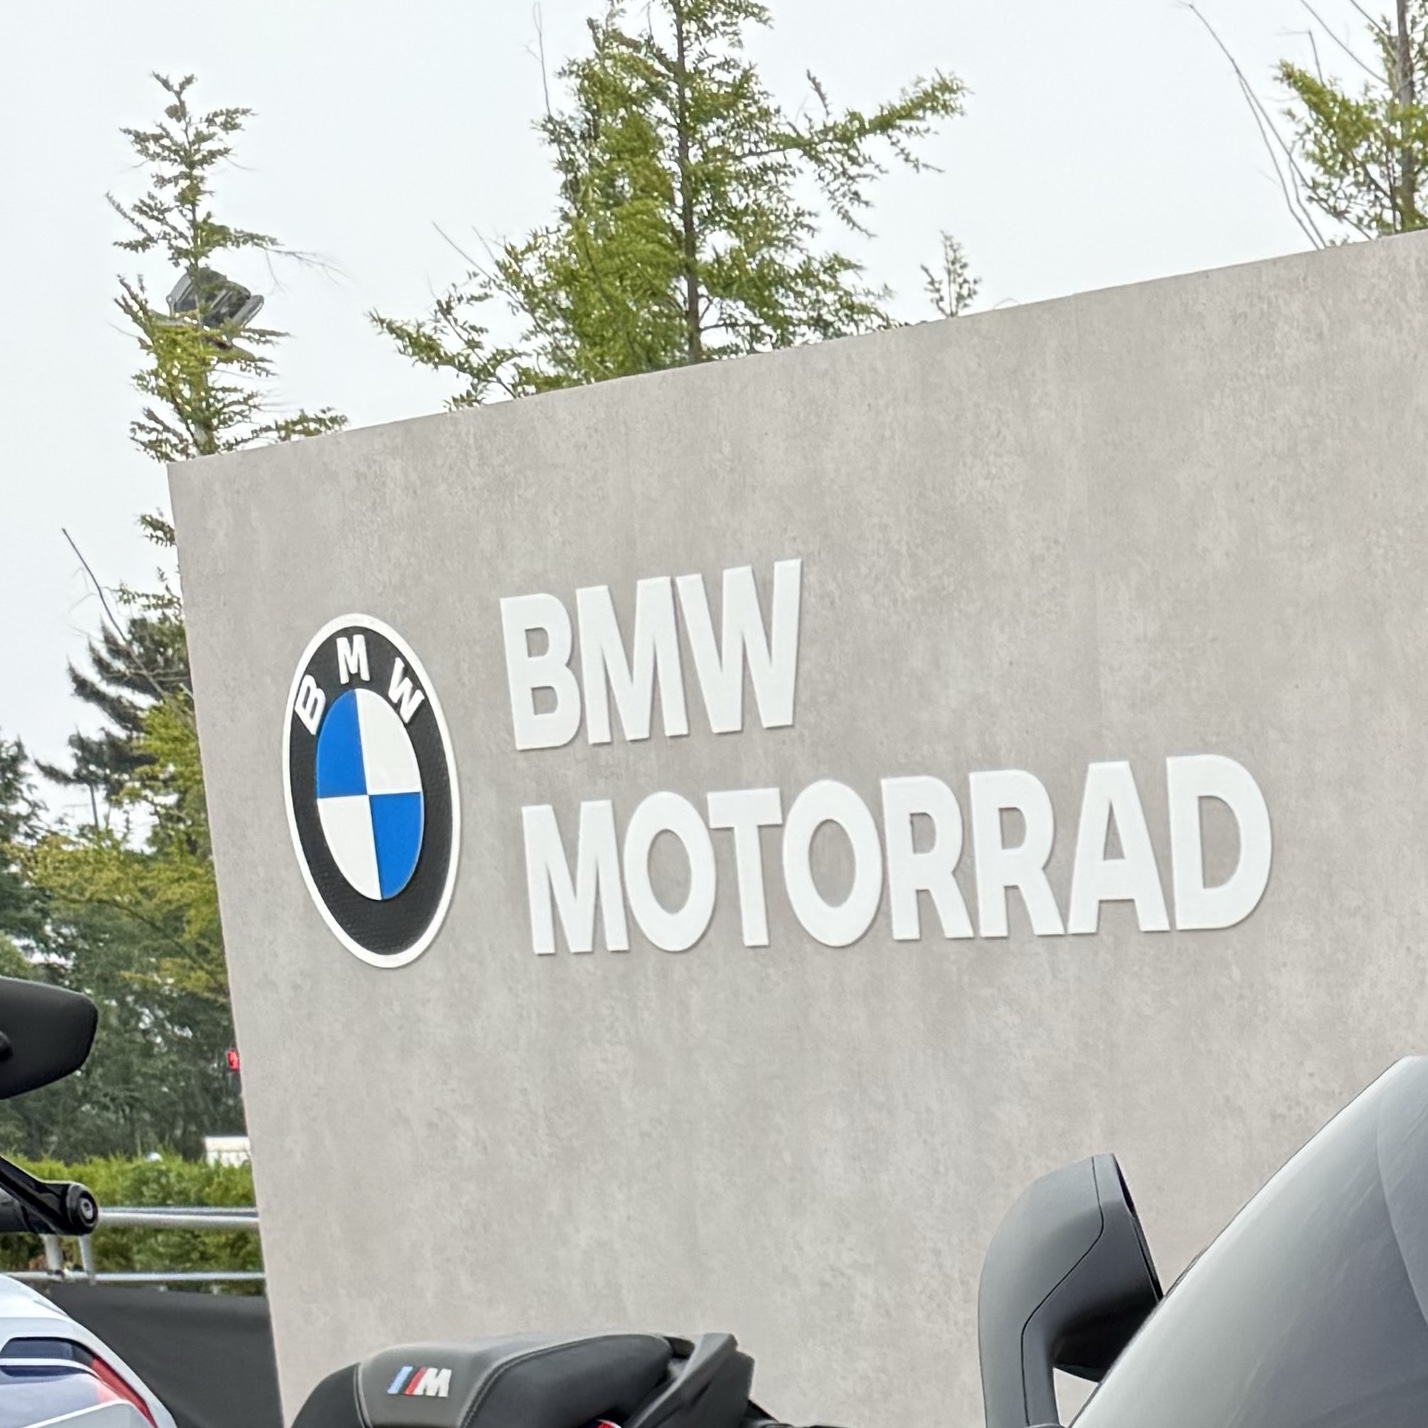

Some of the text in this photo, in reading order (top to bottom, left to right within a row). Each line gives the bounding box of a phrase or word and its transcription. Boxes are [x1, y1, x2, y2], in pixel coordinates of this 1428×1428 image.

[295, 633, 426, 735] BMW
[499, 559, 801, 750] BMW
[521, 753, 1272, 955] MOTORRAD
